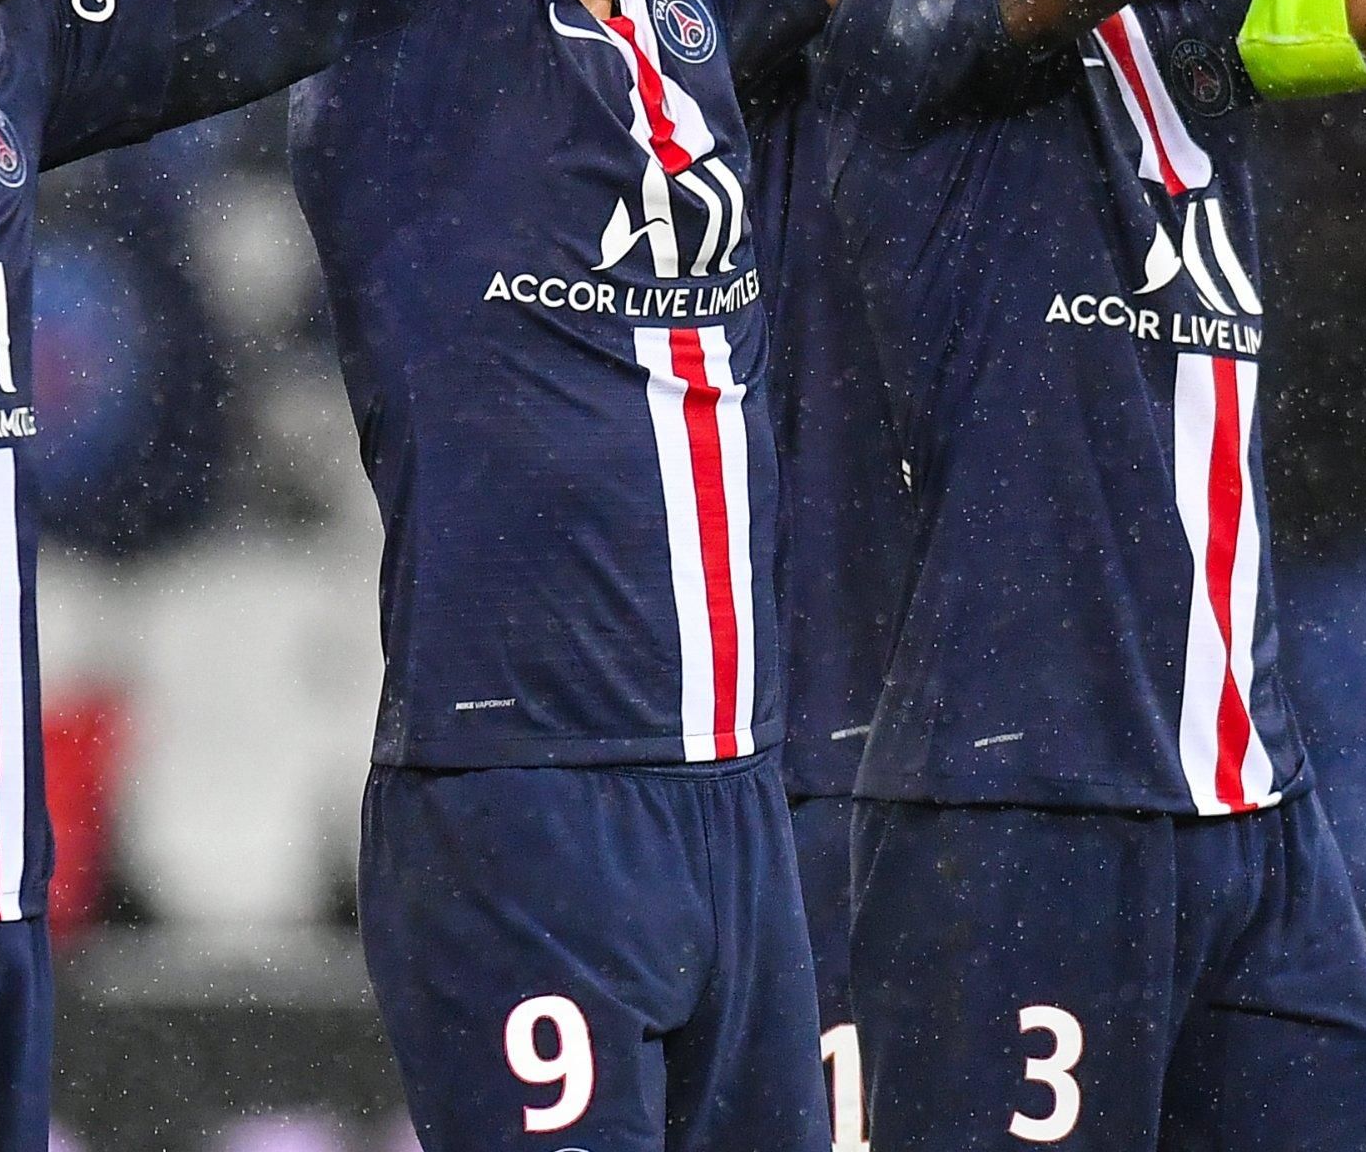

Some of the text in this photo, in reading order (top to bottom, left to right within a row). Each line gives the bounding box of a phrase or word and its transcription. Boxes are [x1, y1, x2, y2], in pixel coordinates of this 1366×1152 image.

[483, 271, 617, 314] ACCOR
[625, 288, 690, 318] LIVE
[1172, 313, 1231, 350] LIVE
[503, 993, 595, 1133] 9
[819, 1022, 871, 1152] 1
[1007, 1004, 1084, 1144] 3
